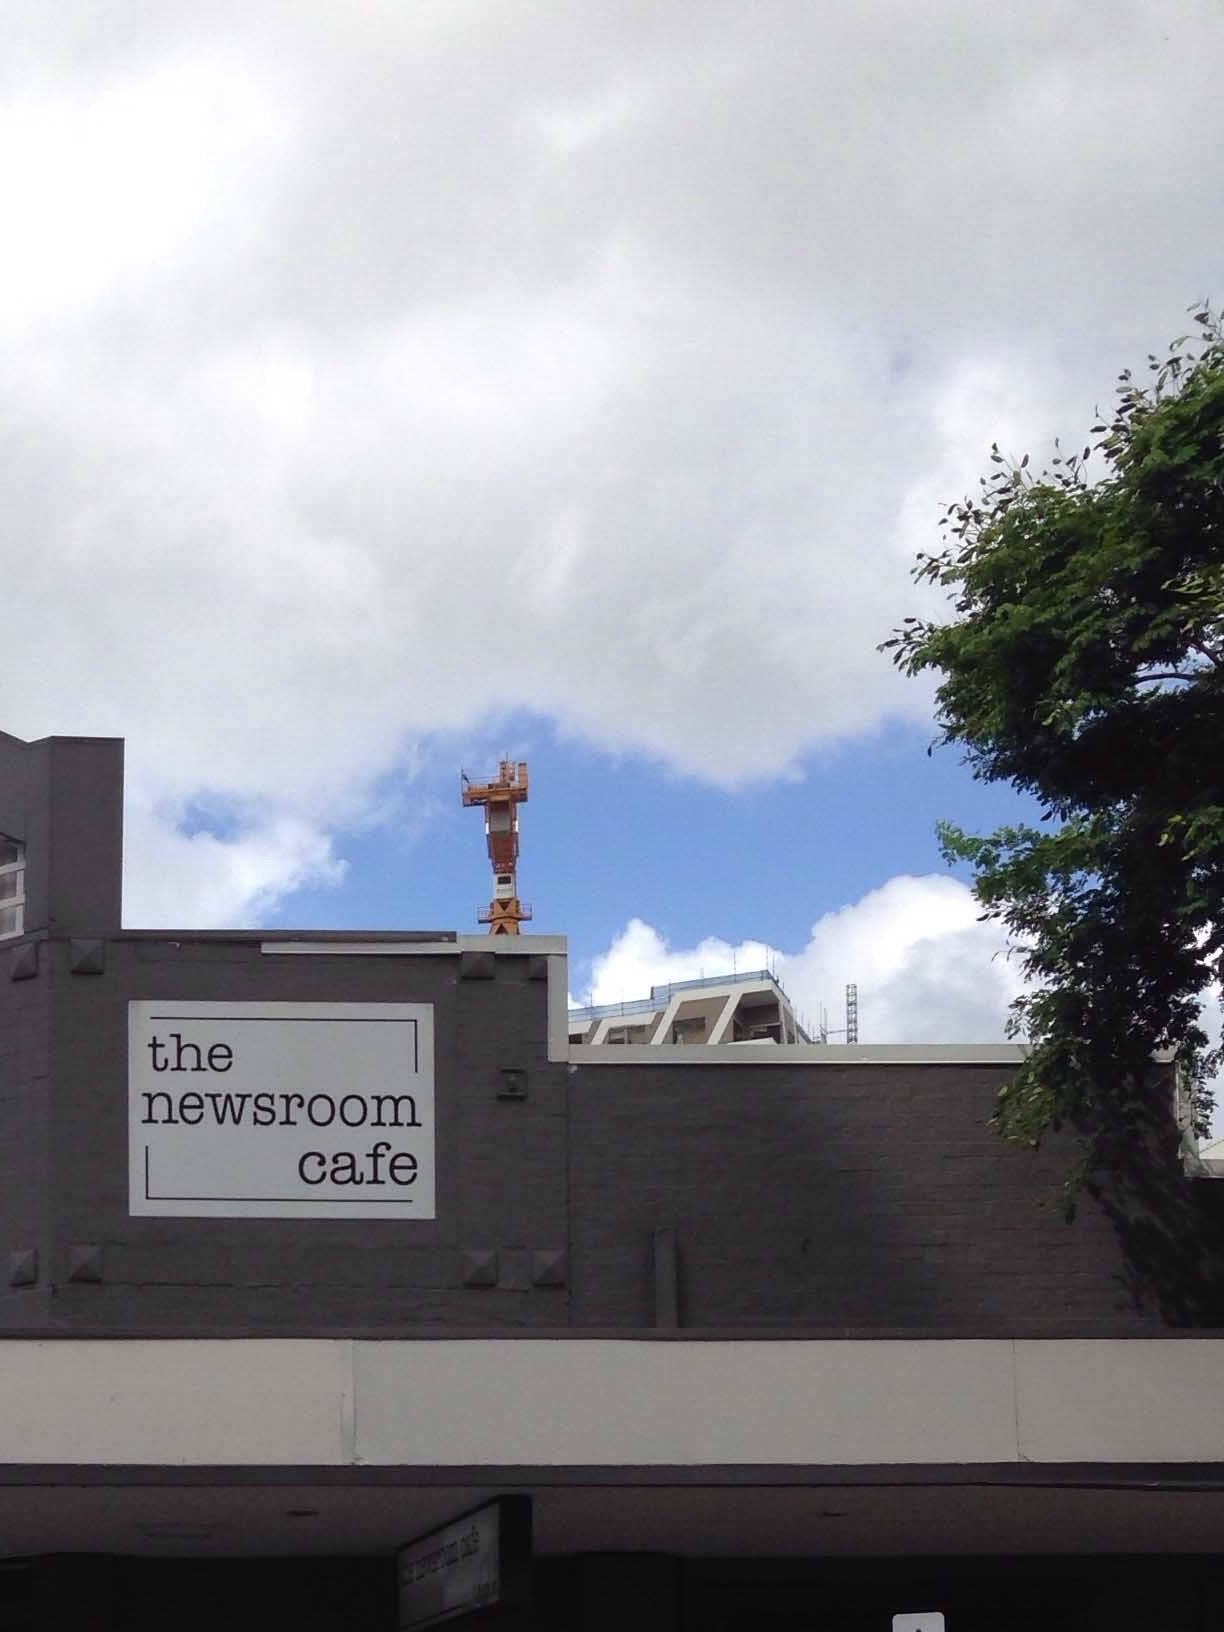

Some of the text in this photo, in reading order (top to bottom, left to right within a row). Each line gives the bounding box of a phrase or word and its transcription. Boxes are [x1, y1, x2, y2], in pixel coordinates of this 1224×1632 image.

[148, 1033, 234, 1073] the
[141, 1090, 423, 1127] newsroom
[298, 1142, 419, 1186] cafe
